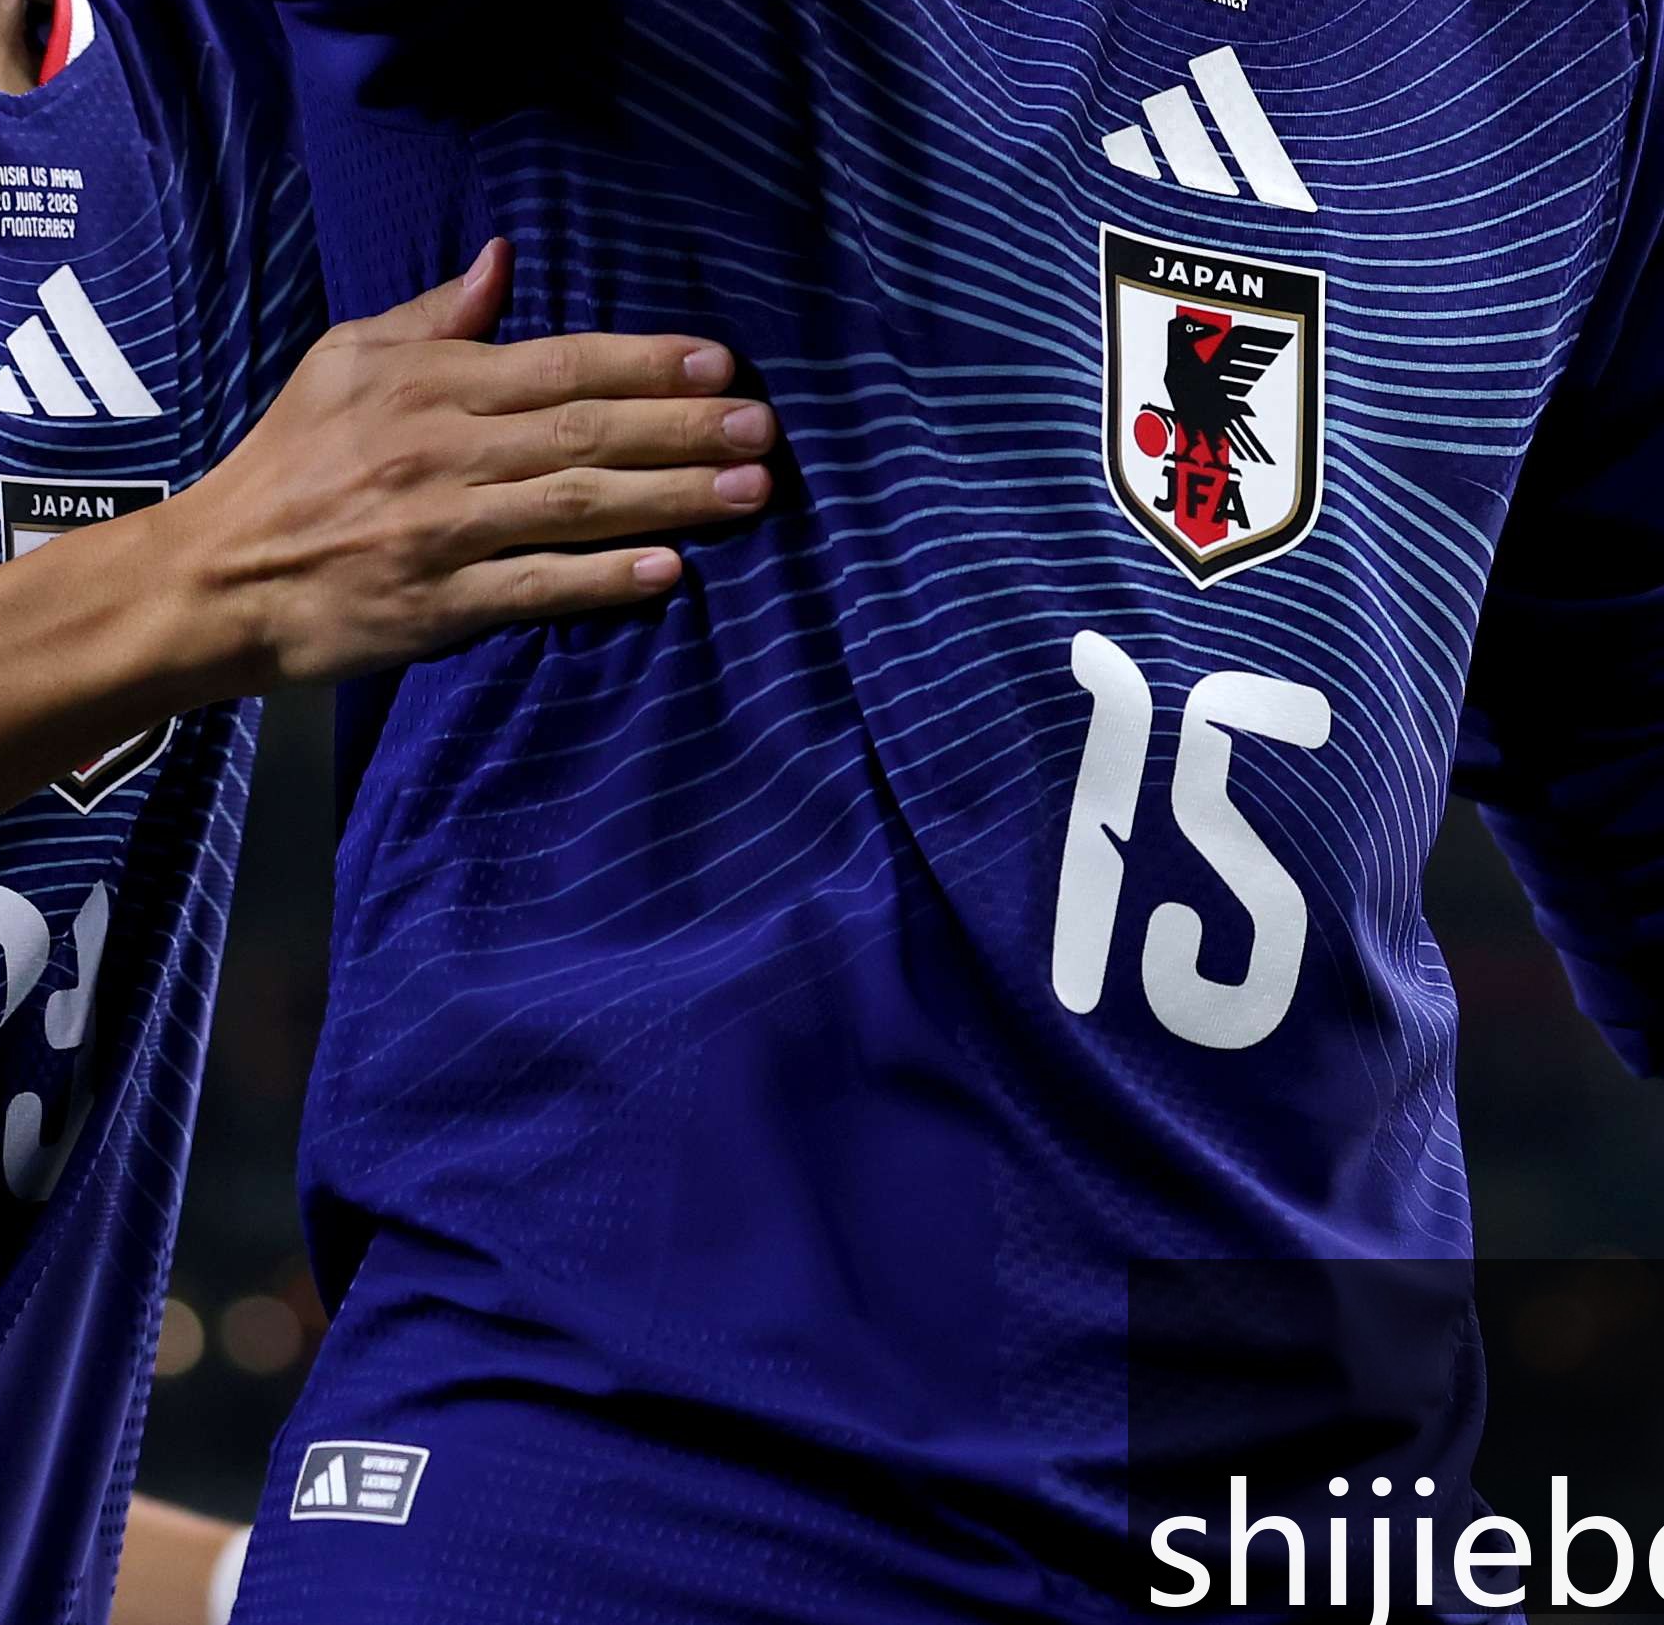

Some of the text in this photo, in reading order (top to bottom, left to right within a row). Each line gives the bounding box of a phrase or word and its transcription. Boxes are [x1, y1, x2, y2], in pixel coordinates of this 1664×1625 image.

[50, 168, 83, 190] JAPAN
[15, 191, 44, 212] JUNE
[47, 192, 78, 214] 2026
[1, 216, 75, 239] MONTERREY
[1148, 255, 1264, 300] JAPAN
[30, 493, 115, 519] JAPAN
[1153, 467, 1251, 529] JFA
[1052, 629, 1331, 1049] 15
